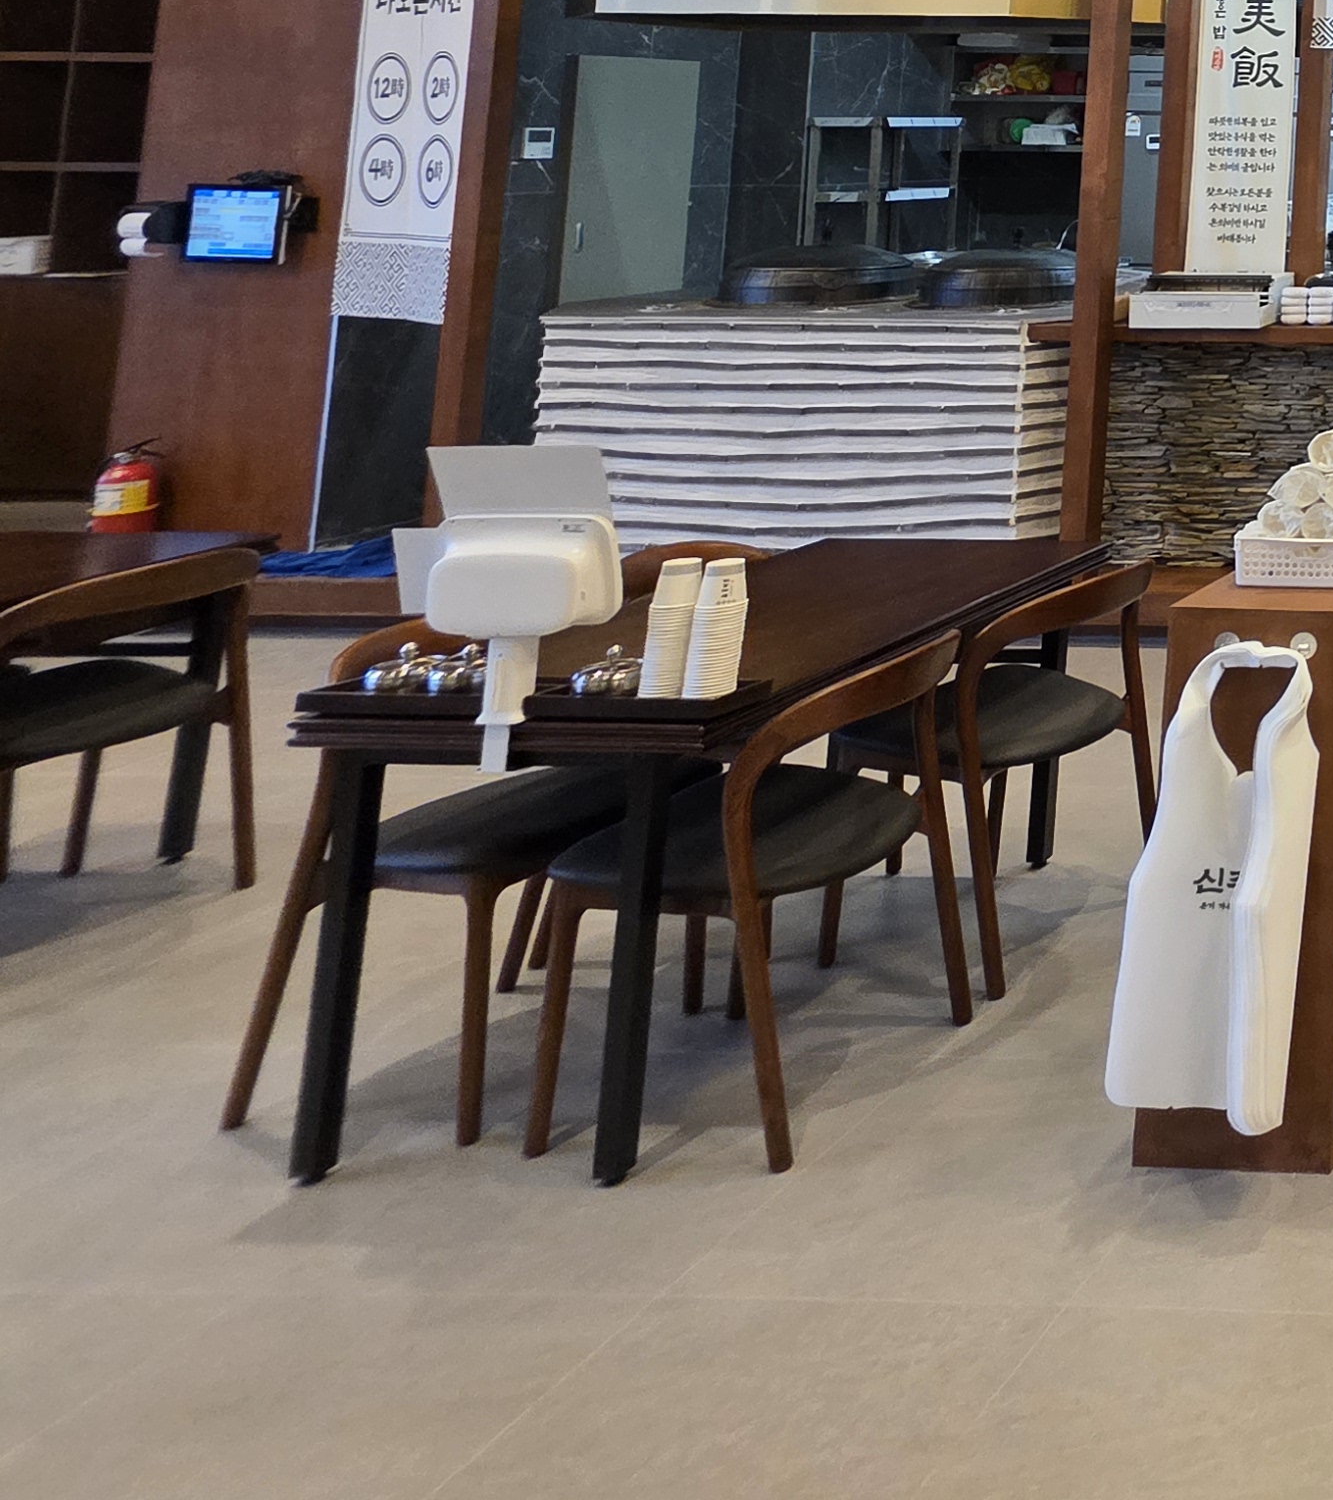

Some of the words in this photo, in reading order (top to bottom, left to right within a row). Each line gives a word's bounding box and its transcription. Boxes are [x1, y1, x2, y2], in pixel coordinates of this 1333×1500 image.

[1212, 25, 1226, 40] 밥
[374, 77, 404, 99] 12時
[430, 77, 451, 99] 2時
[368, 158, 394, 181] 4時
[425, 159, 443, 183] 6時
